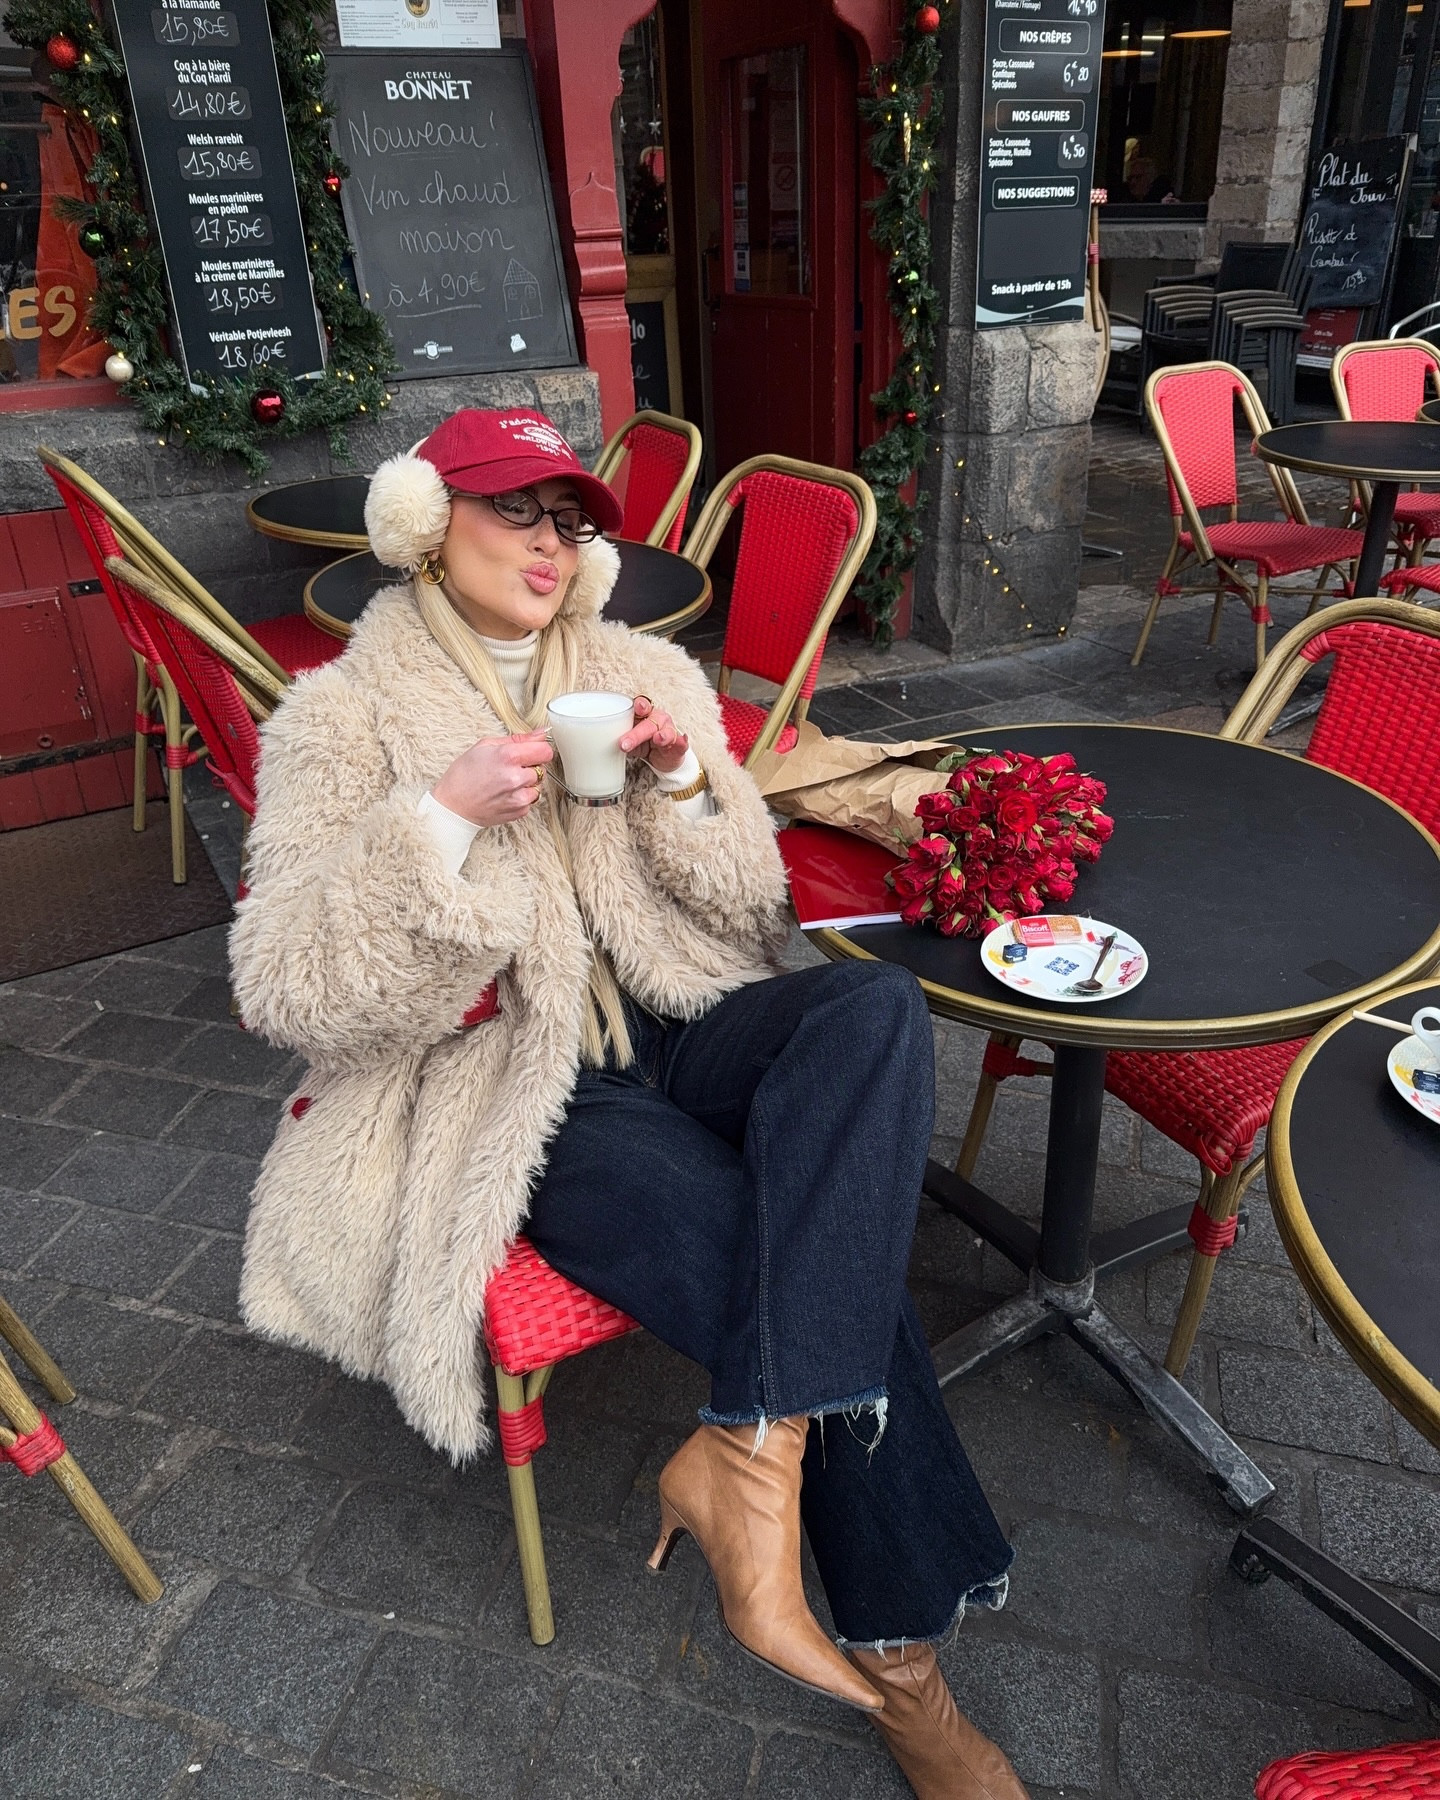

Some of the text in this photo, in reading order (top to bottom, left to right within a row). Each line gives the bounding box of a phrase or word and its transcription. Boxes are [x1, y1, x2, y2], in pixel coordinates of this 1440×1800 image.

[170, 0, 178, 8] la
[180, 0, 220, 9] flamande
[160, 13, 229, 46] 15,80€
[1020, 30, 1072, 44] NOS CRÊPES
[174, 59, 230, 72] Coq à la bière
[992, 59, 1035, 69] Sucre, Cassonade
[177, 72, 231, 85] du Coq Hardi
[405, 71, 451, 79] CHATEAU
[992, 69, 1016, 79] Confiture
[384, 80, 472, 100] BONNET
[992, 79, 1017, 90] Spéculoos
[172, 89, 246, 117] 14,80€
[1012, 110, 1070, 122] NOS GAUFRES
[187, 133, 243, 145] Welsh rarebit
[348, 111, 487, 157] Nouveau
[989, 137, 1031, 148] Sucre, Cassonade
[989, 147, 1032, 157] Confiture, Nutella
[184, 151, 254, 178] 15,80€
[988, 158, 1013, 169] Spéculoos
[1319, 153, 1373, 188] Plat du
[188, 191, 263, 204] Moules marinières
[357, 169, 520, 215] Vin chaud
[998, 186, 1075, 199] NOS SUGGESTIONS
[208, 203, 249, 217] en poêlon
[195, 218, 265, 248] 17,50€
[399, 223, 515, 254] maison
[201, 258, 275, 272] Moules marinières
[195, 272, 201, 283] à
[201, 271, 211, 282] la
[212, 270, 236, 282] crème
[237, 269, 247, 280] de
[385, 271, 485, 310] à 4,90€
[991, 278, 1072, 295] Snack à partir de 15h
[208, 282, 276, 316] 18,50€
[0, 285, 77, 339] ES
[209, 326, 292, 343] Véritable Potjevleesh
[1022, 924, 1050, 933] Biscoff
